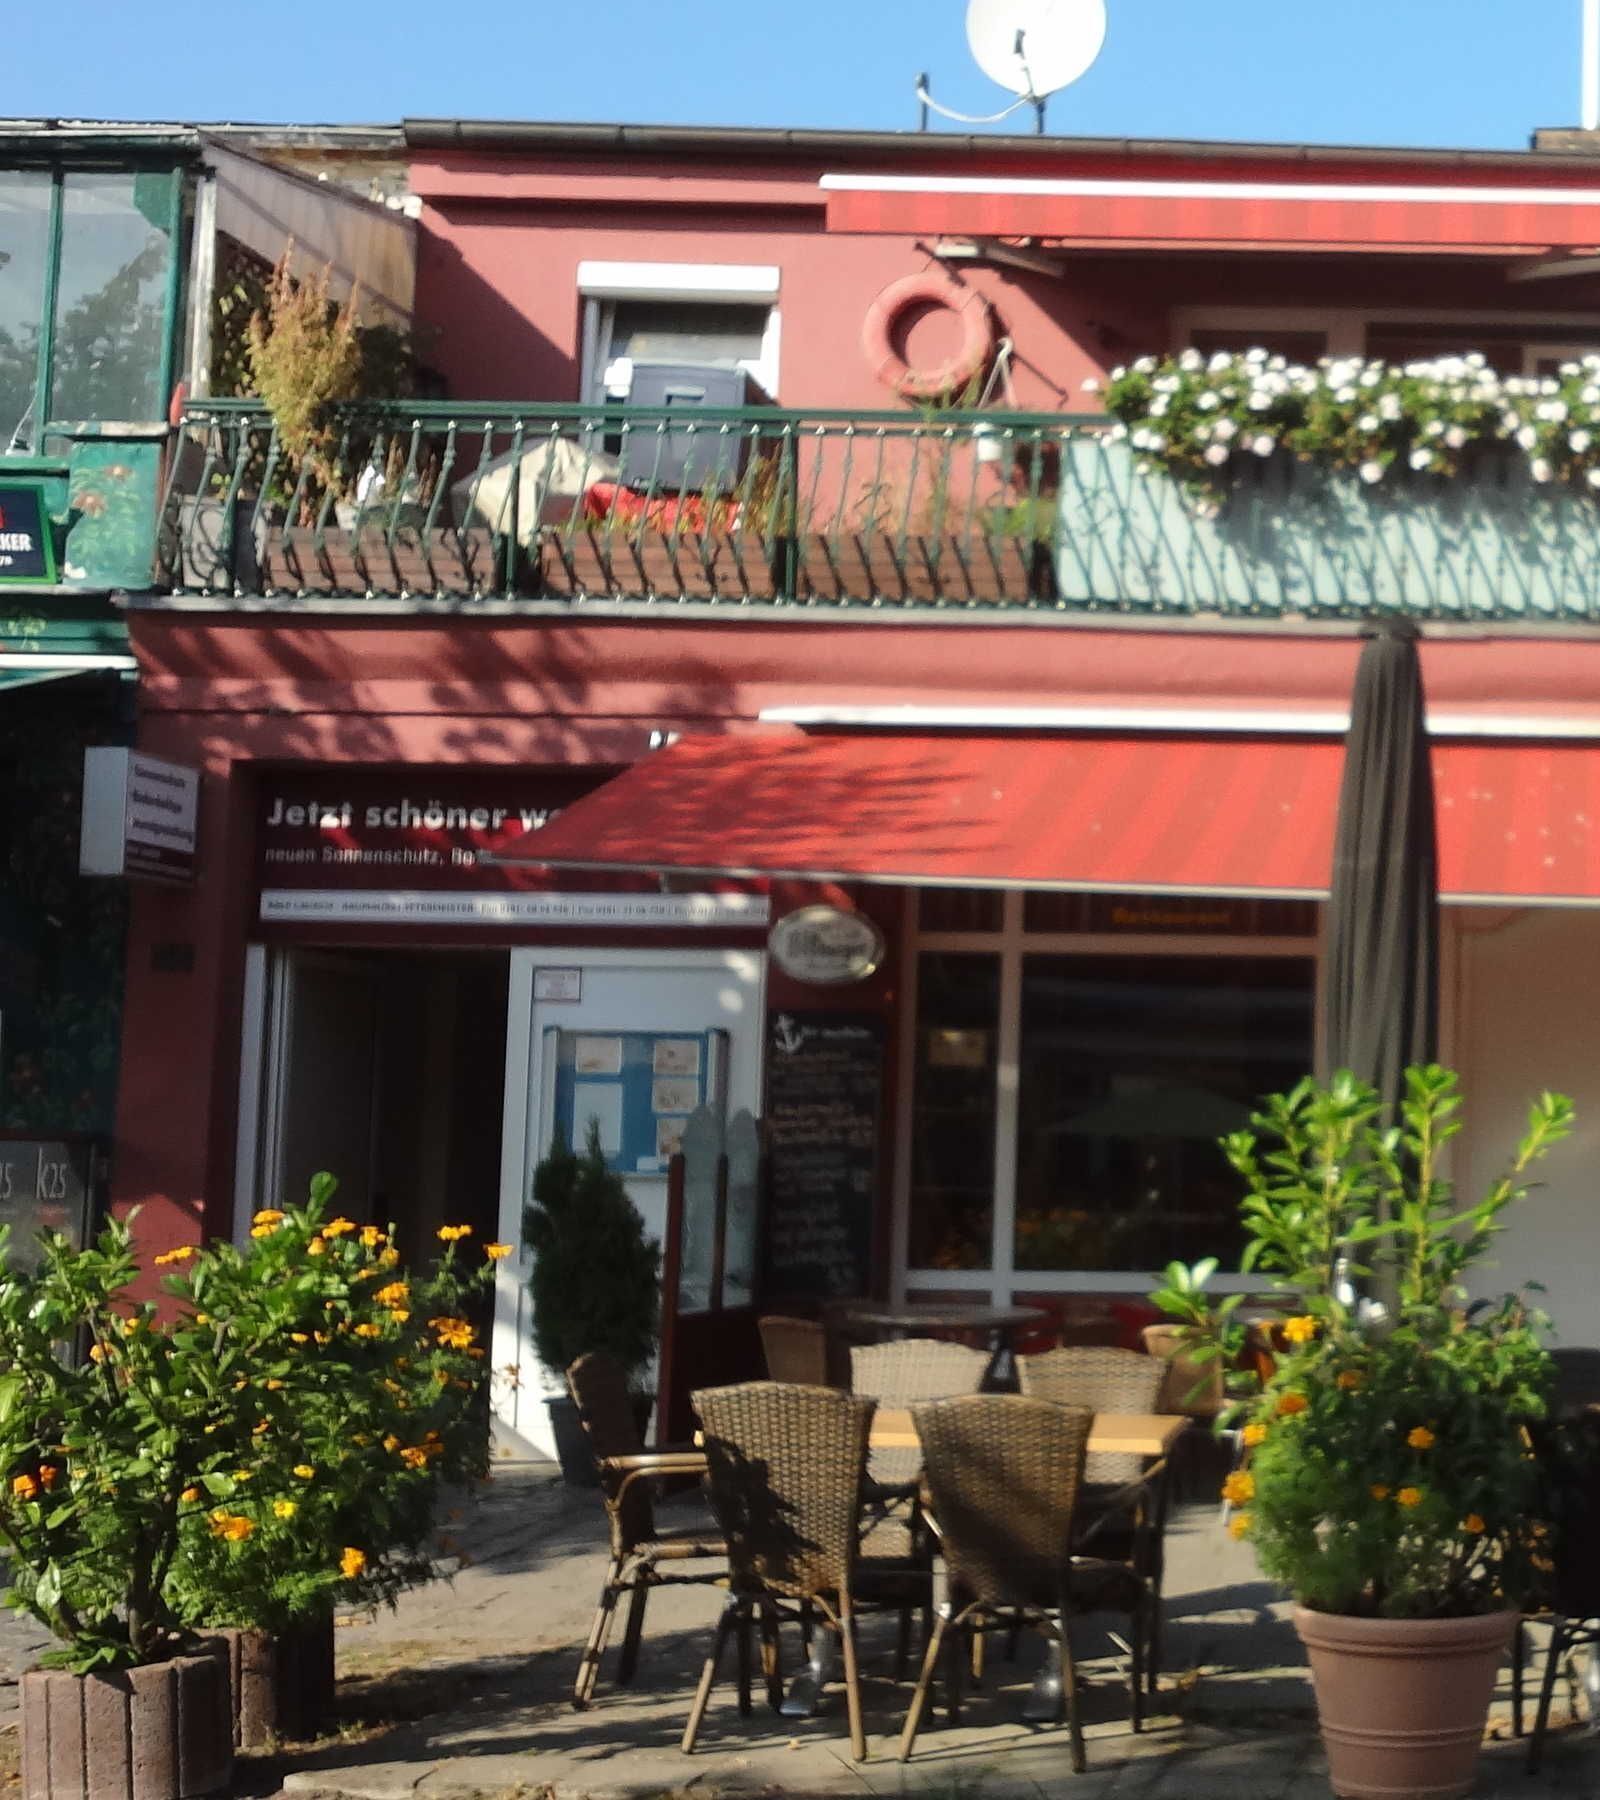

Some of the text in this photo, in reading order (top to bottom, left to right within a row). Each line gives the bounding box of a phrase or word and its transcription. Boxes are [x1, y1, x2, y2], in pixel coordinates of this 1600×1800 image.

[267, 798, 351, 828] Jetzt
[366, 798, 508, 831] schöner
[265, 850, 316, 864] neuen
